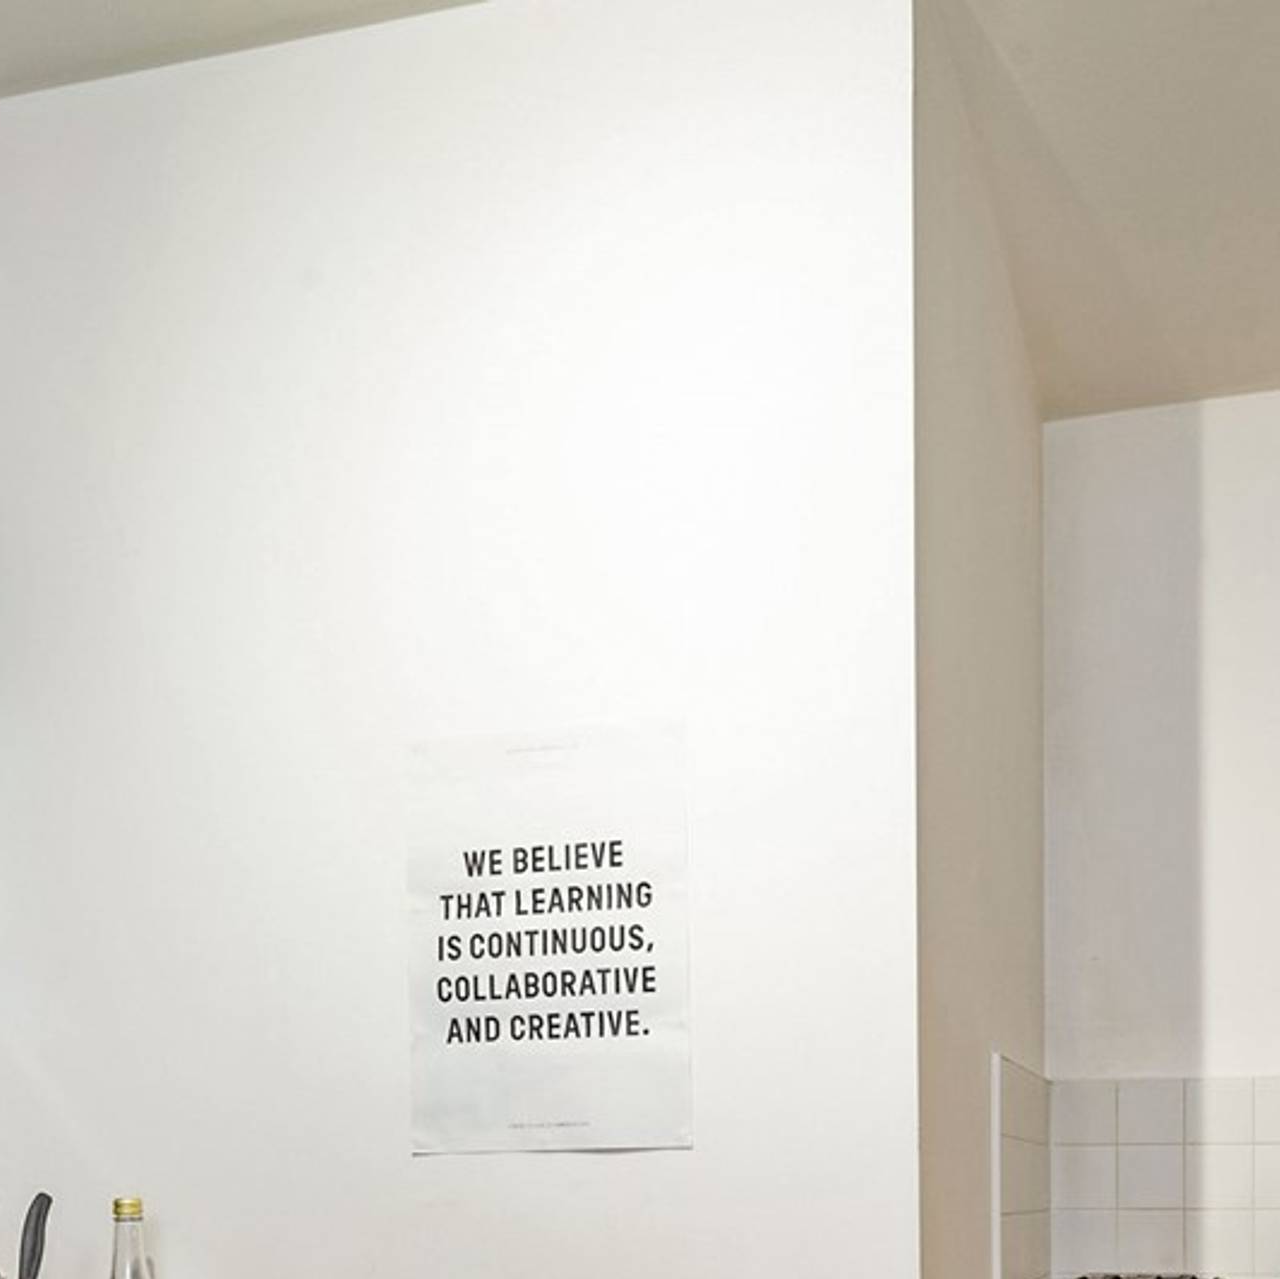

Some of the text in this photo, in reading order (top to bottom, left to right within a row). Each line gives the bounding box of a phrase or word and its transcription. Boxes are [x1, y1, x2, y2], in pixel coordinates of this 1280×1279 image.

[463, 840, 623, 878] WE BELIEVE
[439, 881, 652, 921] THAT LEARNING
[438, 924, 654, 962] IS CONTINUOUS,
[437, 965, 656, 1003] COLLABORATIVE
[446, 1009, 650, 1045] AND CREATIVE.
